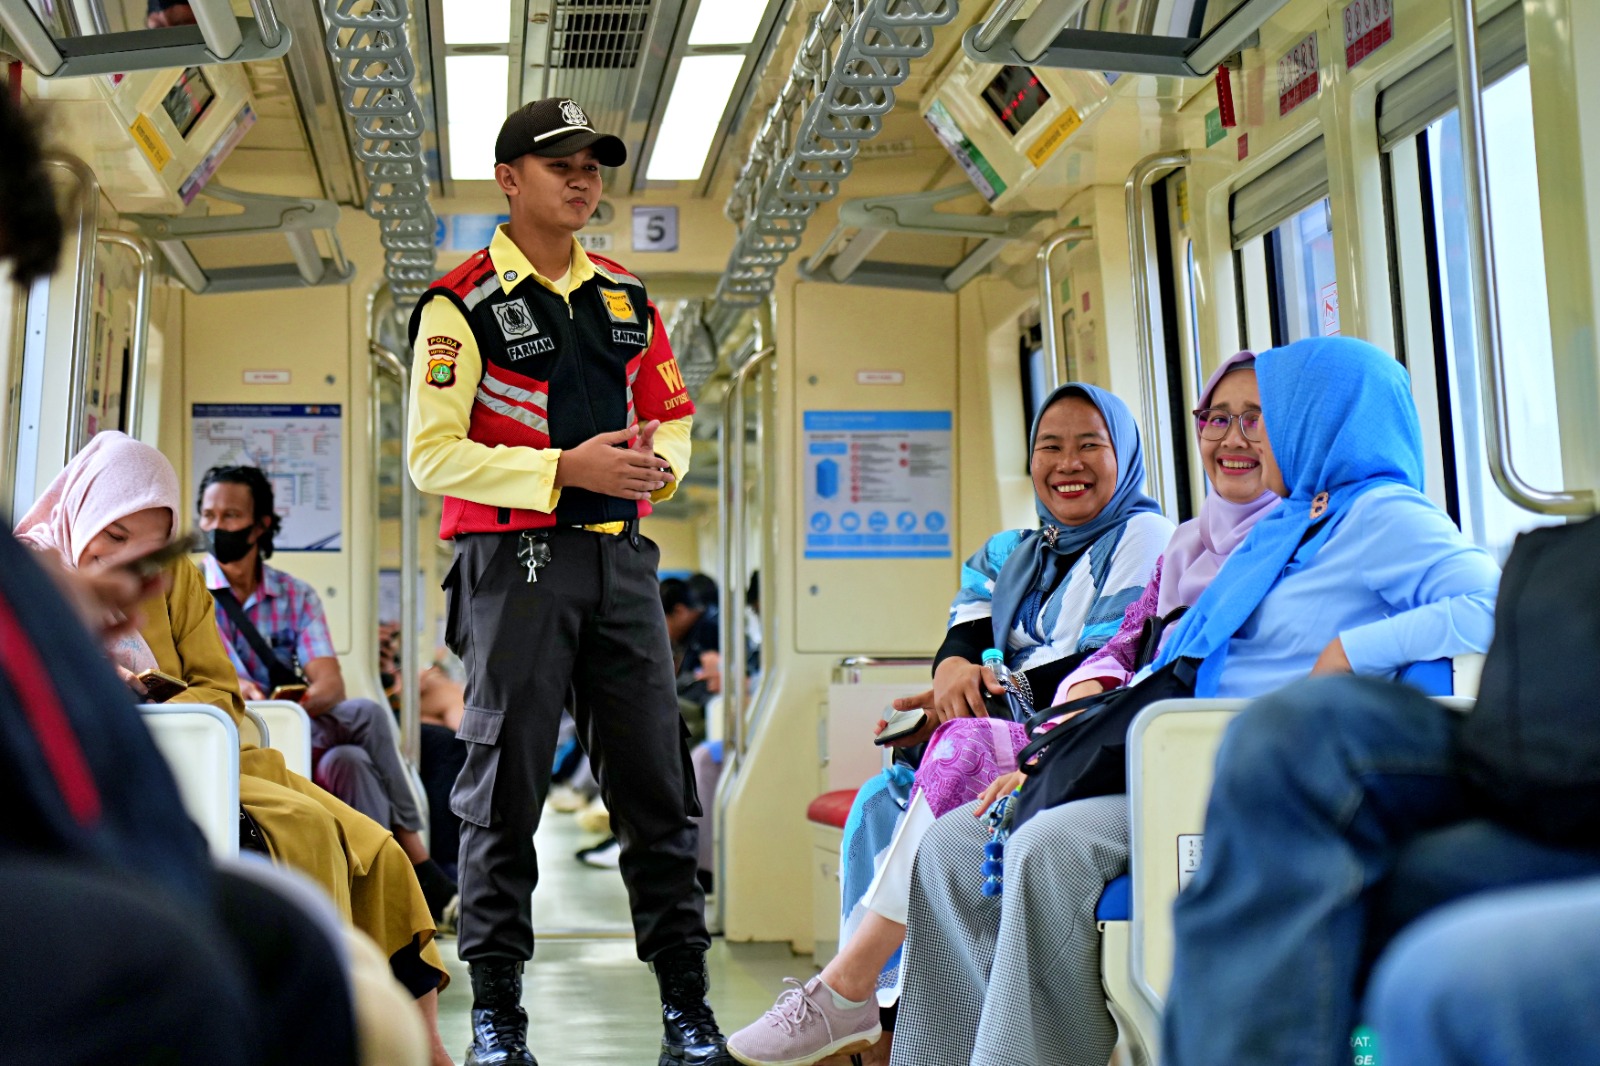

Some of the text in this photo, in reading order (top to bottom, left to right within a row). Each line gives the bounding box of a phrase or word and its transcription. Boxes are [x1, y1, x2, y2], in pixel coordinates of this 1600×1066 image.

[647, 215, 665, 243] 5
[430, 337, 457, 348] POLDA
[613, 330, 646, 346] SATPAM
[508, 338, 553, 360] FARHAN
